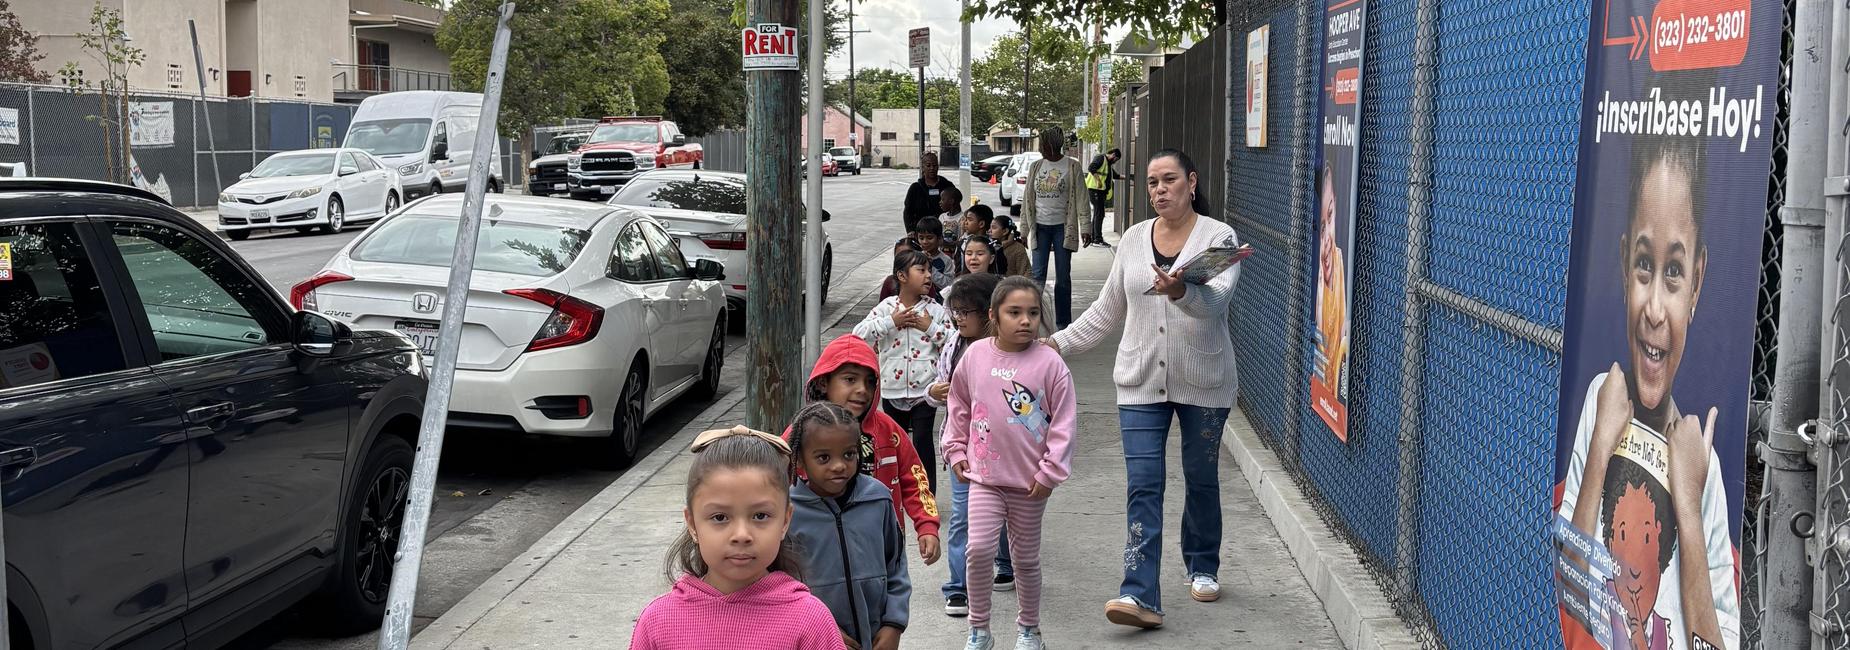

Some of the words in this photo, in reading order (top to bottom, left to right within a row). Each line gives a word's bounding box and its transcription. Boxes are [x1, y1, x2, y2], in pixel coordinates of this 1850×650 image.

[761, 25, 777, 33] FOR
[1329, 11, 1348, 37] HOOPER
[1349, 7, 1361, 32] AVE
[1654, 13, 1685, 54] (323)
[1686, 10, 1746, 45] 232-3801
[744, 29, 795, 56] RENT
[1324, 114, 1341, 146] Enroll
[1596, 87, 1703, 143] ¡Inscríbase
[1707, 84, 1763, 153] Hoy!
[323, 310, 352, 318] CIVIC
[1628, 434, 1641, 456] Are
[1641, 441, 1655, 466] Not
[1559, 523, 1592, 558] Aprendizaje
[1593, 546, 1622, 577] Divertido
[1559, 556, 1593, 593] Preparación
[1563, 590, 1589, 620] Ambiente
